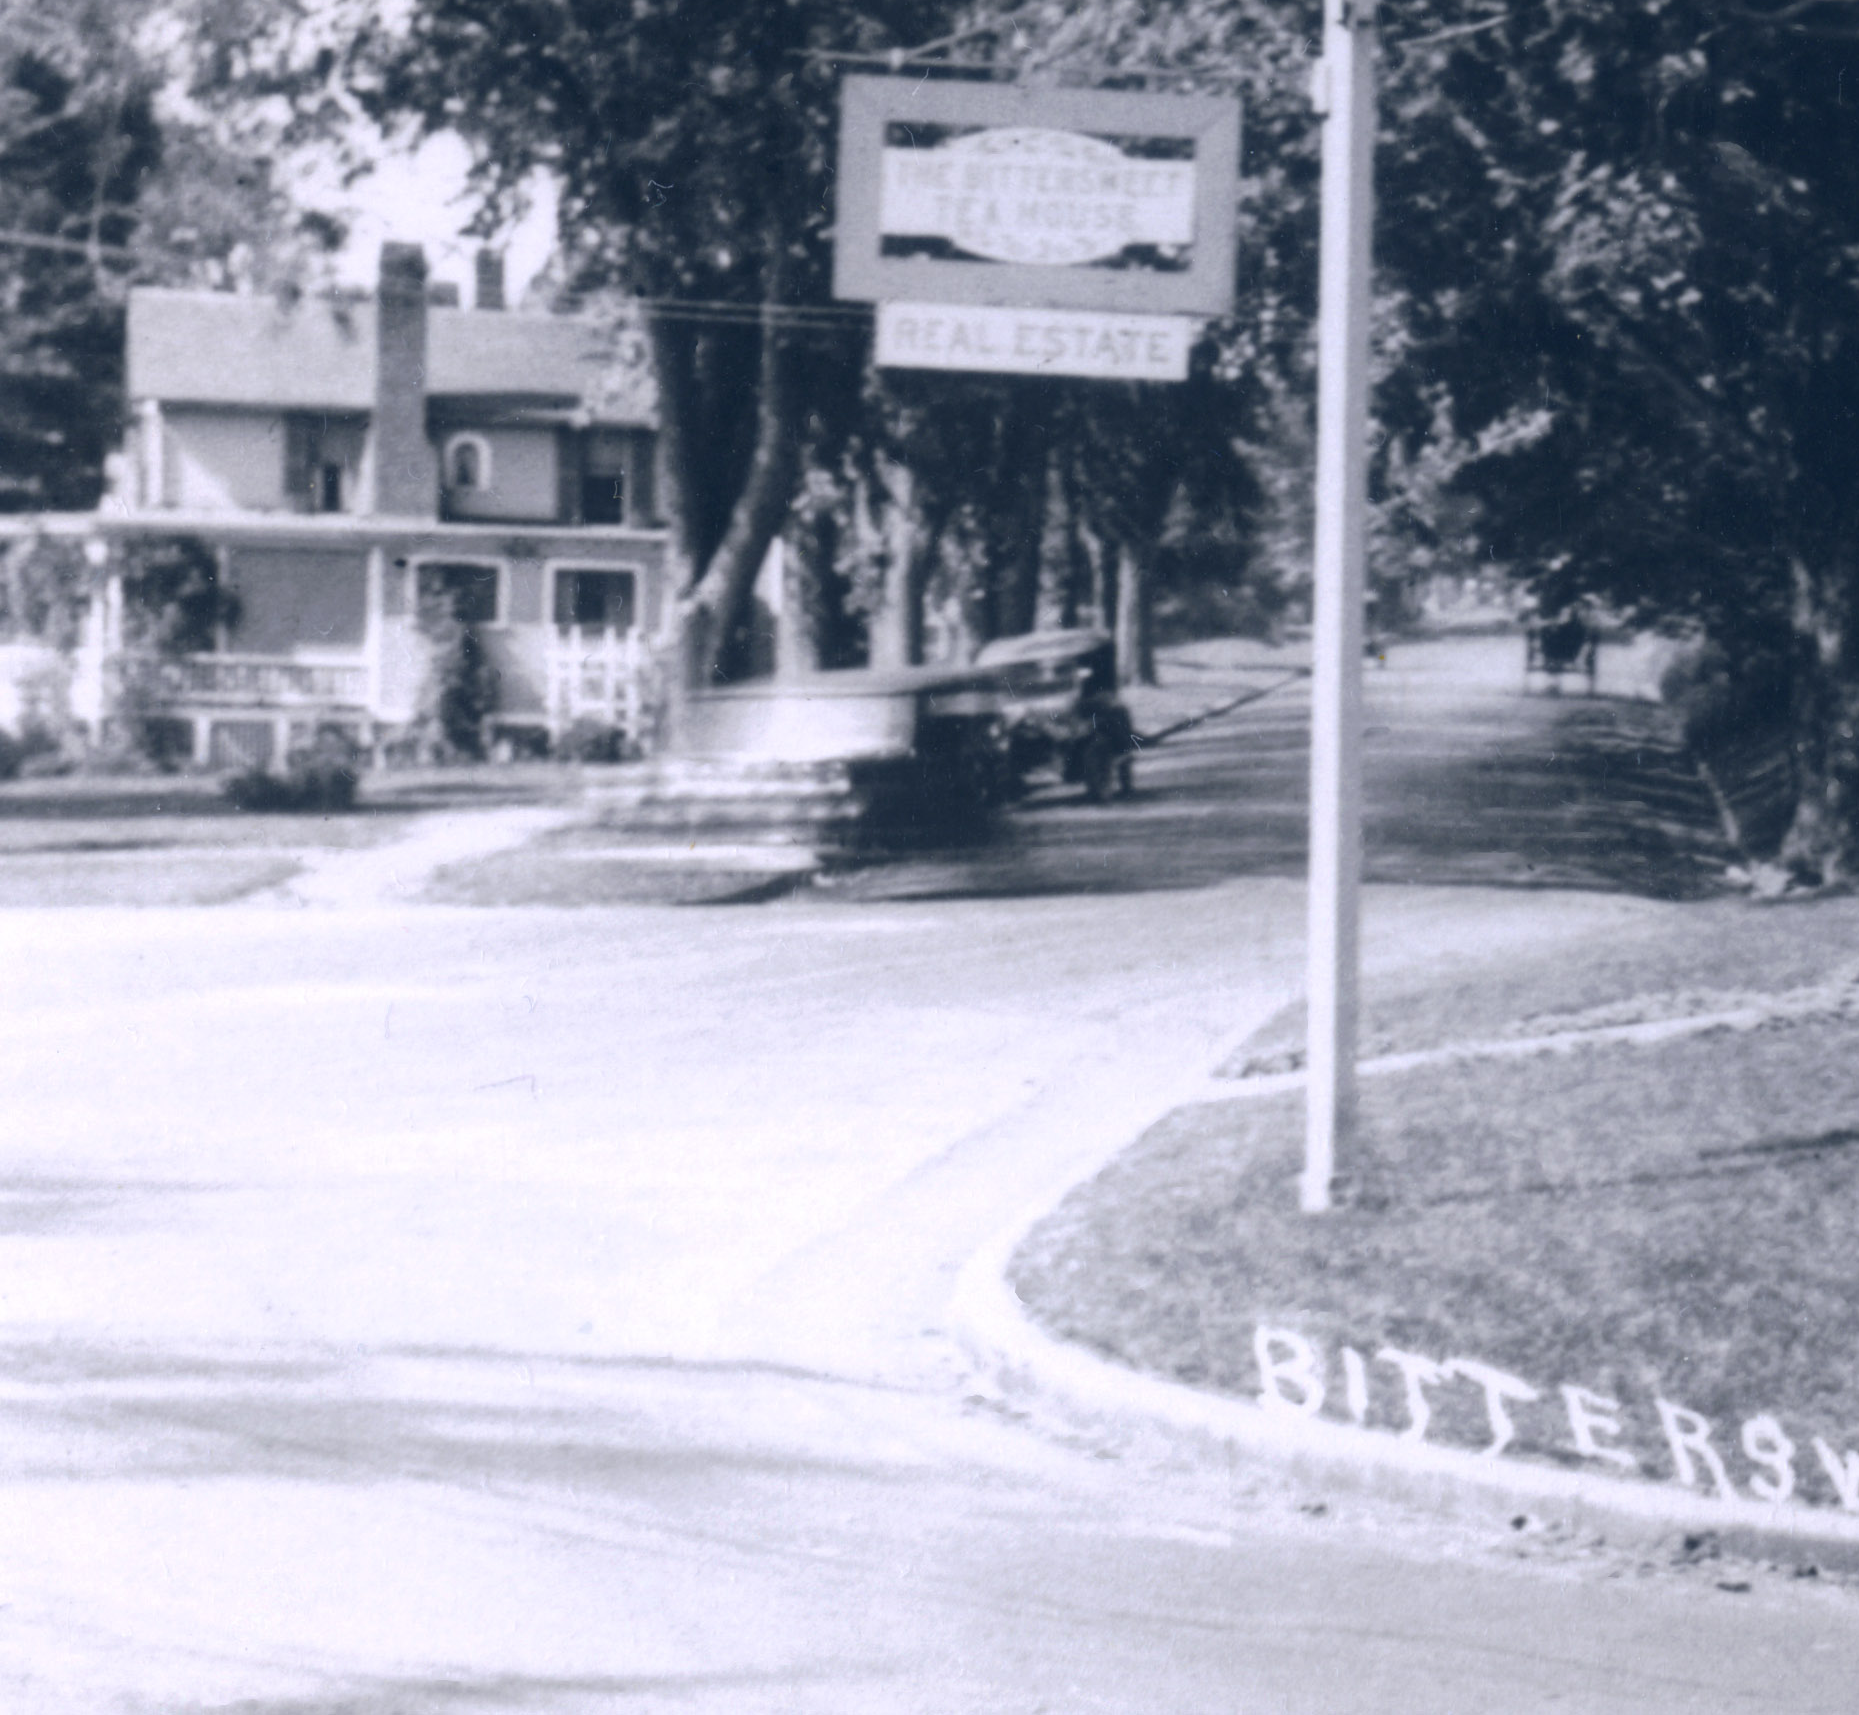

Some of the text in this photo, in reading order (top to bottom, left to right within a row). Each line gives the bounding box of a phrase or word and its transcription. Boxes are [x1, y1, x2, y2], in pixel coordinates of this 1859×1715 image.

[1015, 200, 1136, 233] HOUSE
[894, 316, 1172, 365] REAL ESTATE
